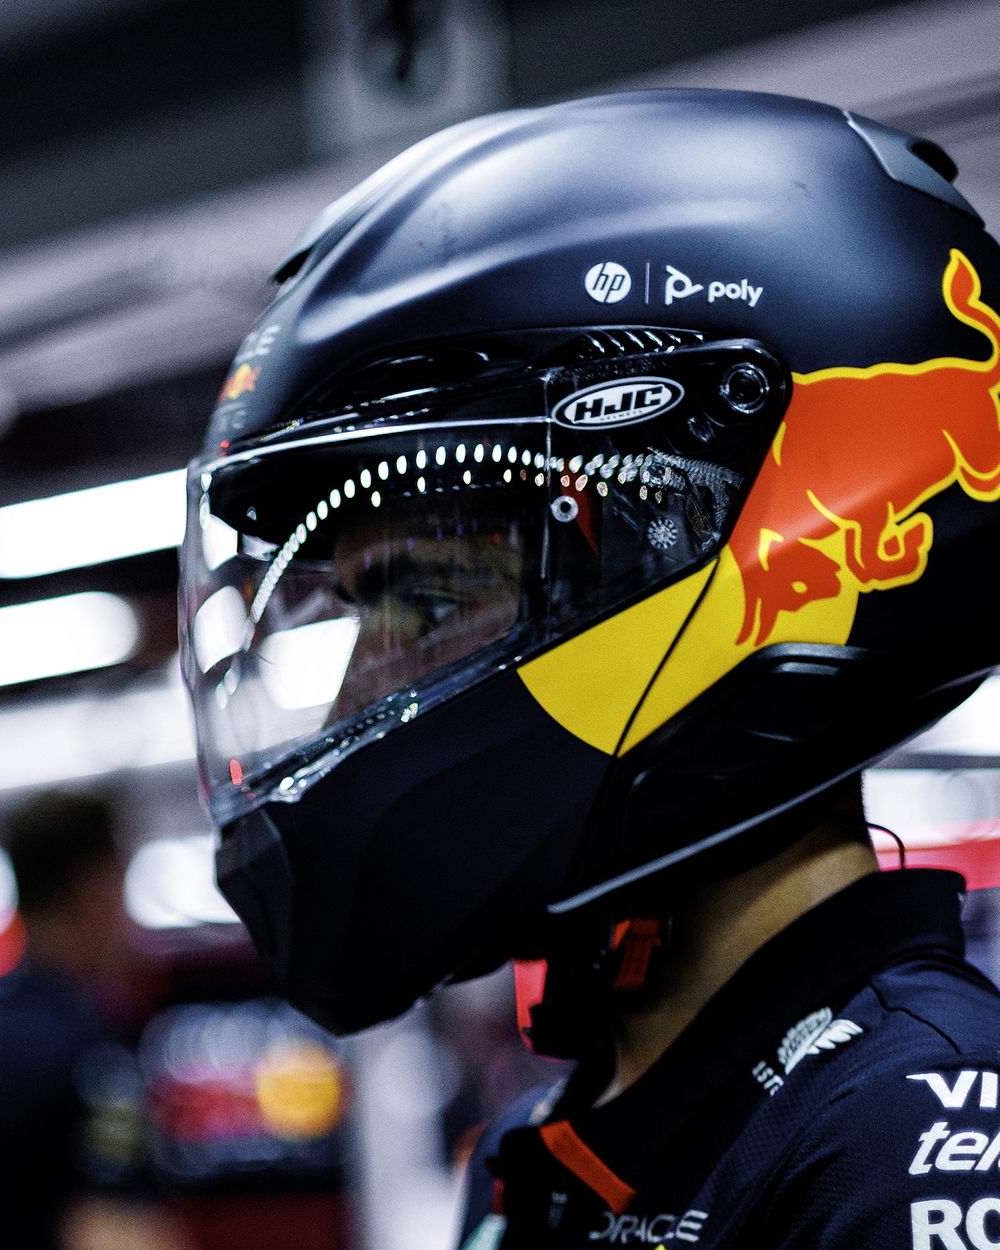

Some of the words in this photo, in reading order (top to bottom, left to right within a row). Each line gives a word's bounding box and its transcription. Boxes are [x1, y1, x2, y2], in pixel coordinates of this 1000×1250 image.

[588, 262, 630, 303] hp
[708, 278, 763, 307] poly
[573, 385, 664, 422] HJC
[905, 1070, 999, 1109] VI
[908, 1121, 1000, 1175] tel
